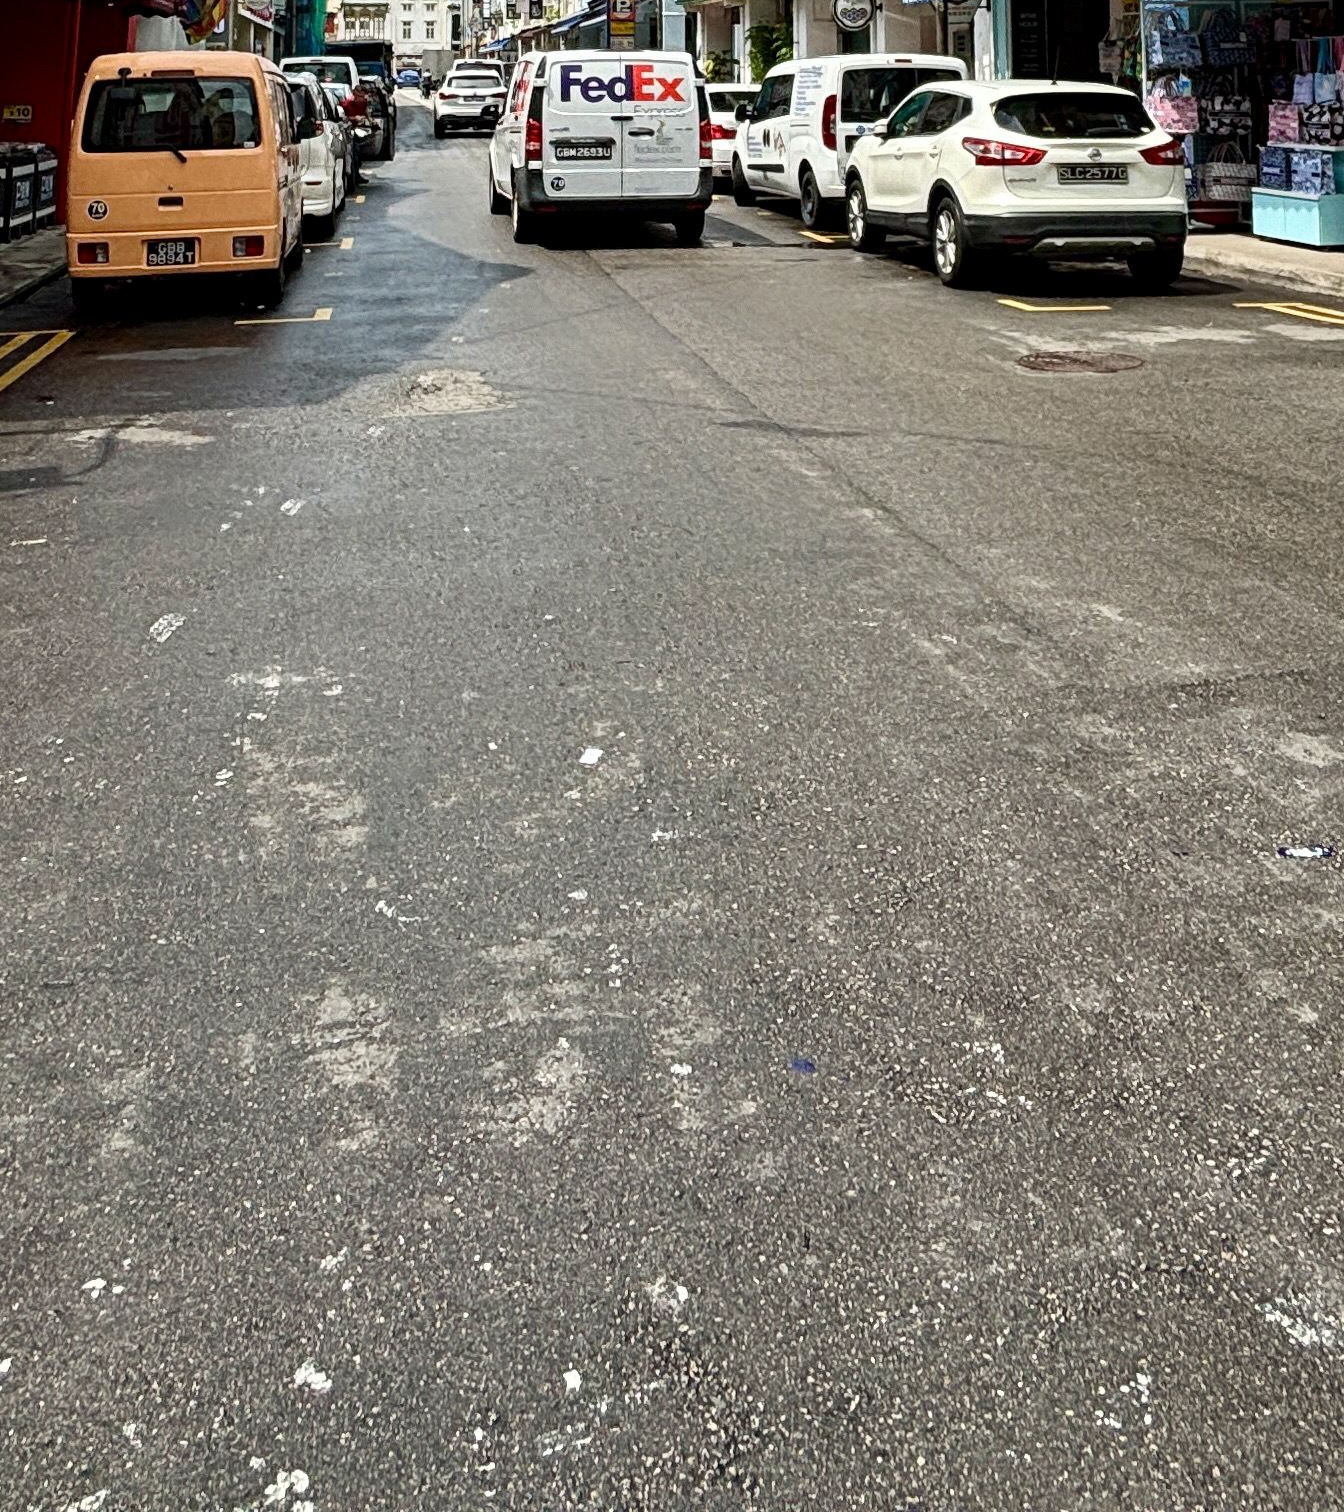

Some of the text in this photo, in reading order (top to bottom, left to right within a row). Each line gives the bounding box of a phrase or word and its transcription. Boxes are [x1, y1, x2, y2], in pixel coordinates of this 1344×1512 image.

[560, 64, 686, 103] FedEx
[1060, 168, 1127, 179] SLC2577G
[91, 202, 106, 214] 70
[158, 242, 185, 254] GBB
